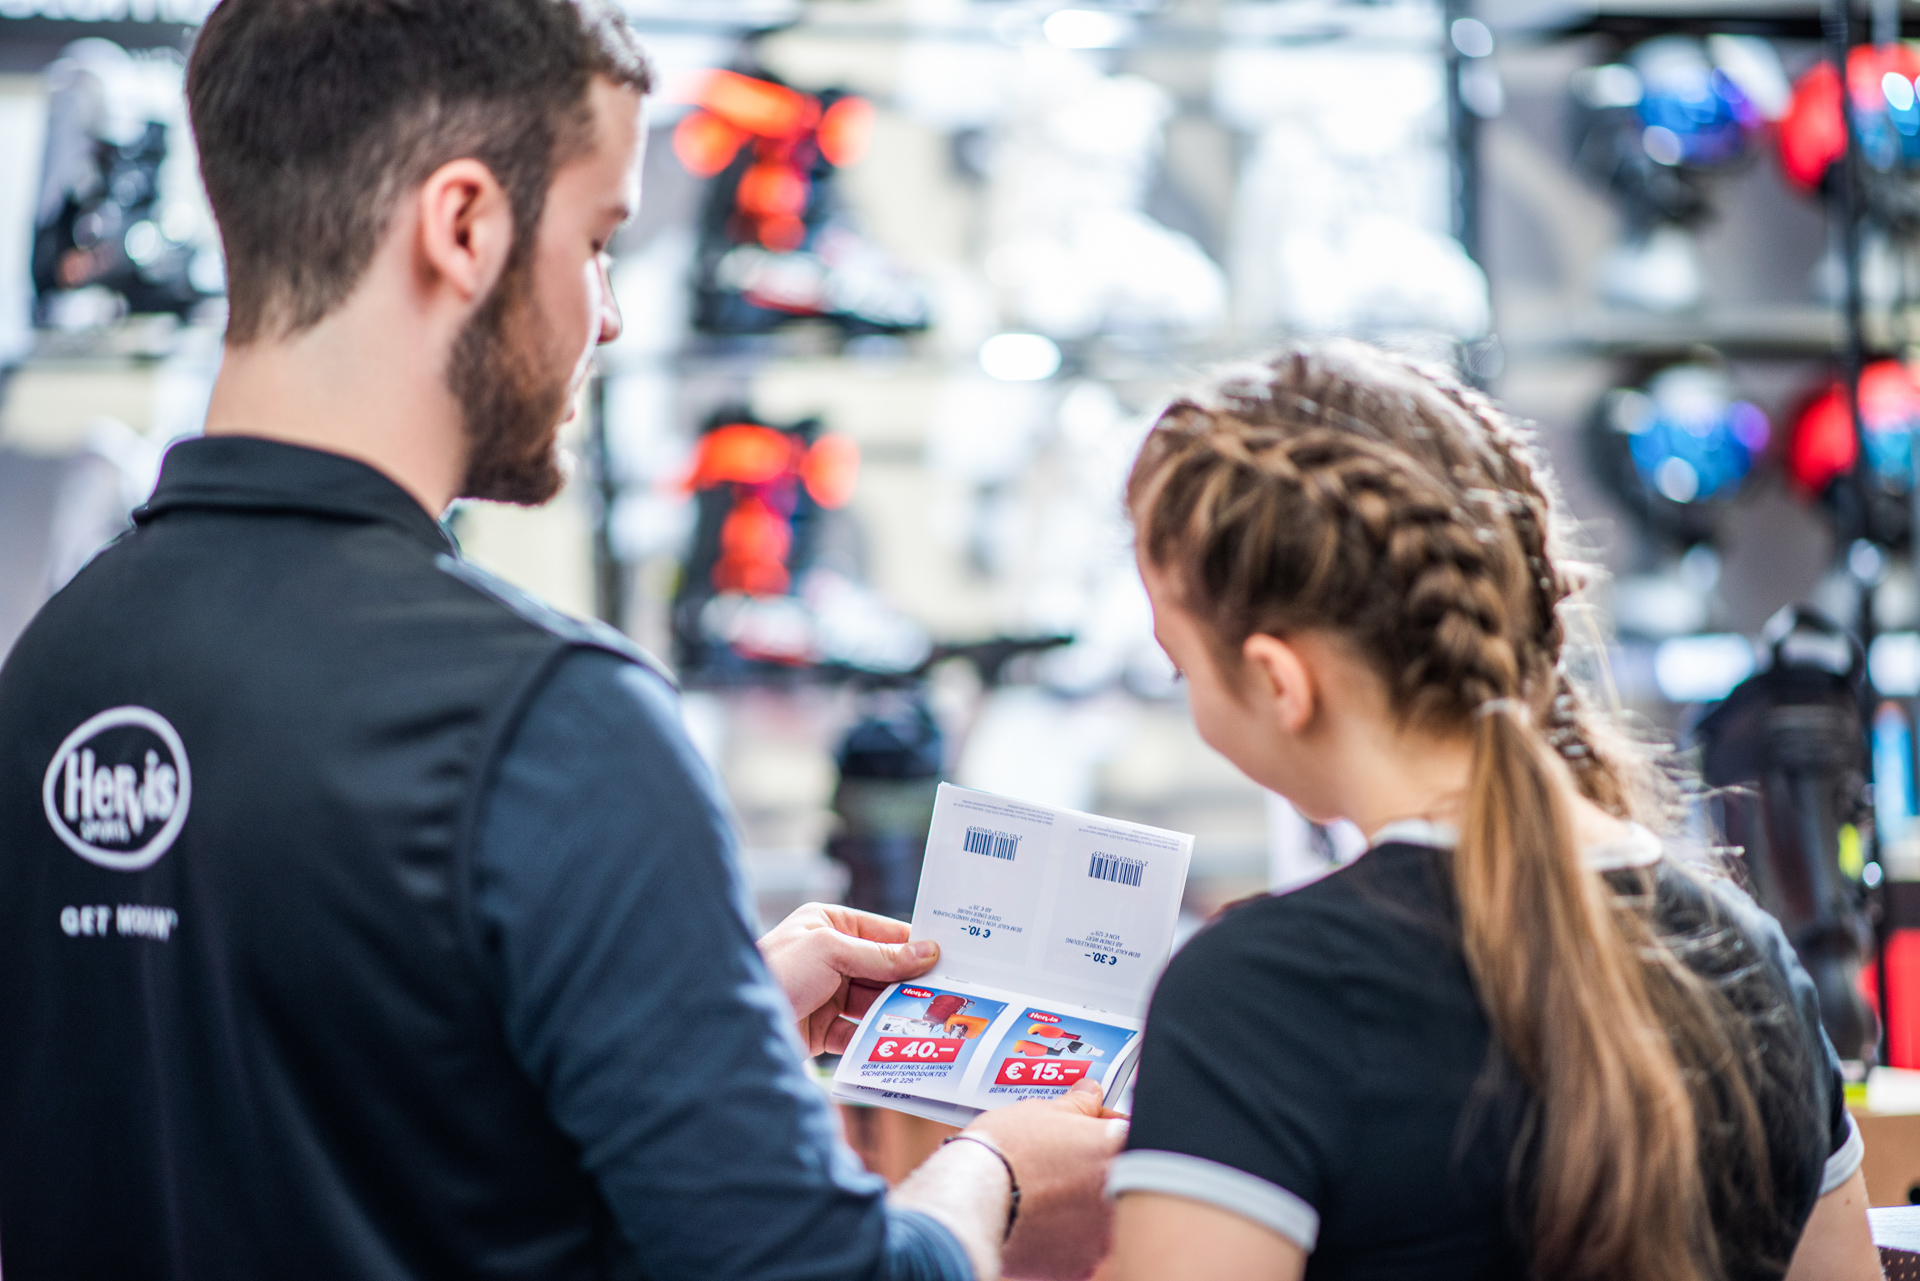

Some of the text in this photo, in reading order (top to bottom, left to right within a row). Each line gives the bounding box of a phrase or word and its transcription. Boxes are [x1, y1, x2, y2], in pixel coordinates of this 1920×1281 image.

[64, 748, 177, 836] Hervis
[60, 905, 112, 937] GET
[988, 914, 1002, 922] ODER
[1127, 951, 1141, 959] BEIM
[877, 1041, 899, 1058] €
[1005, 1062, 1026, 1080] €
